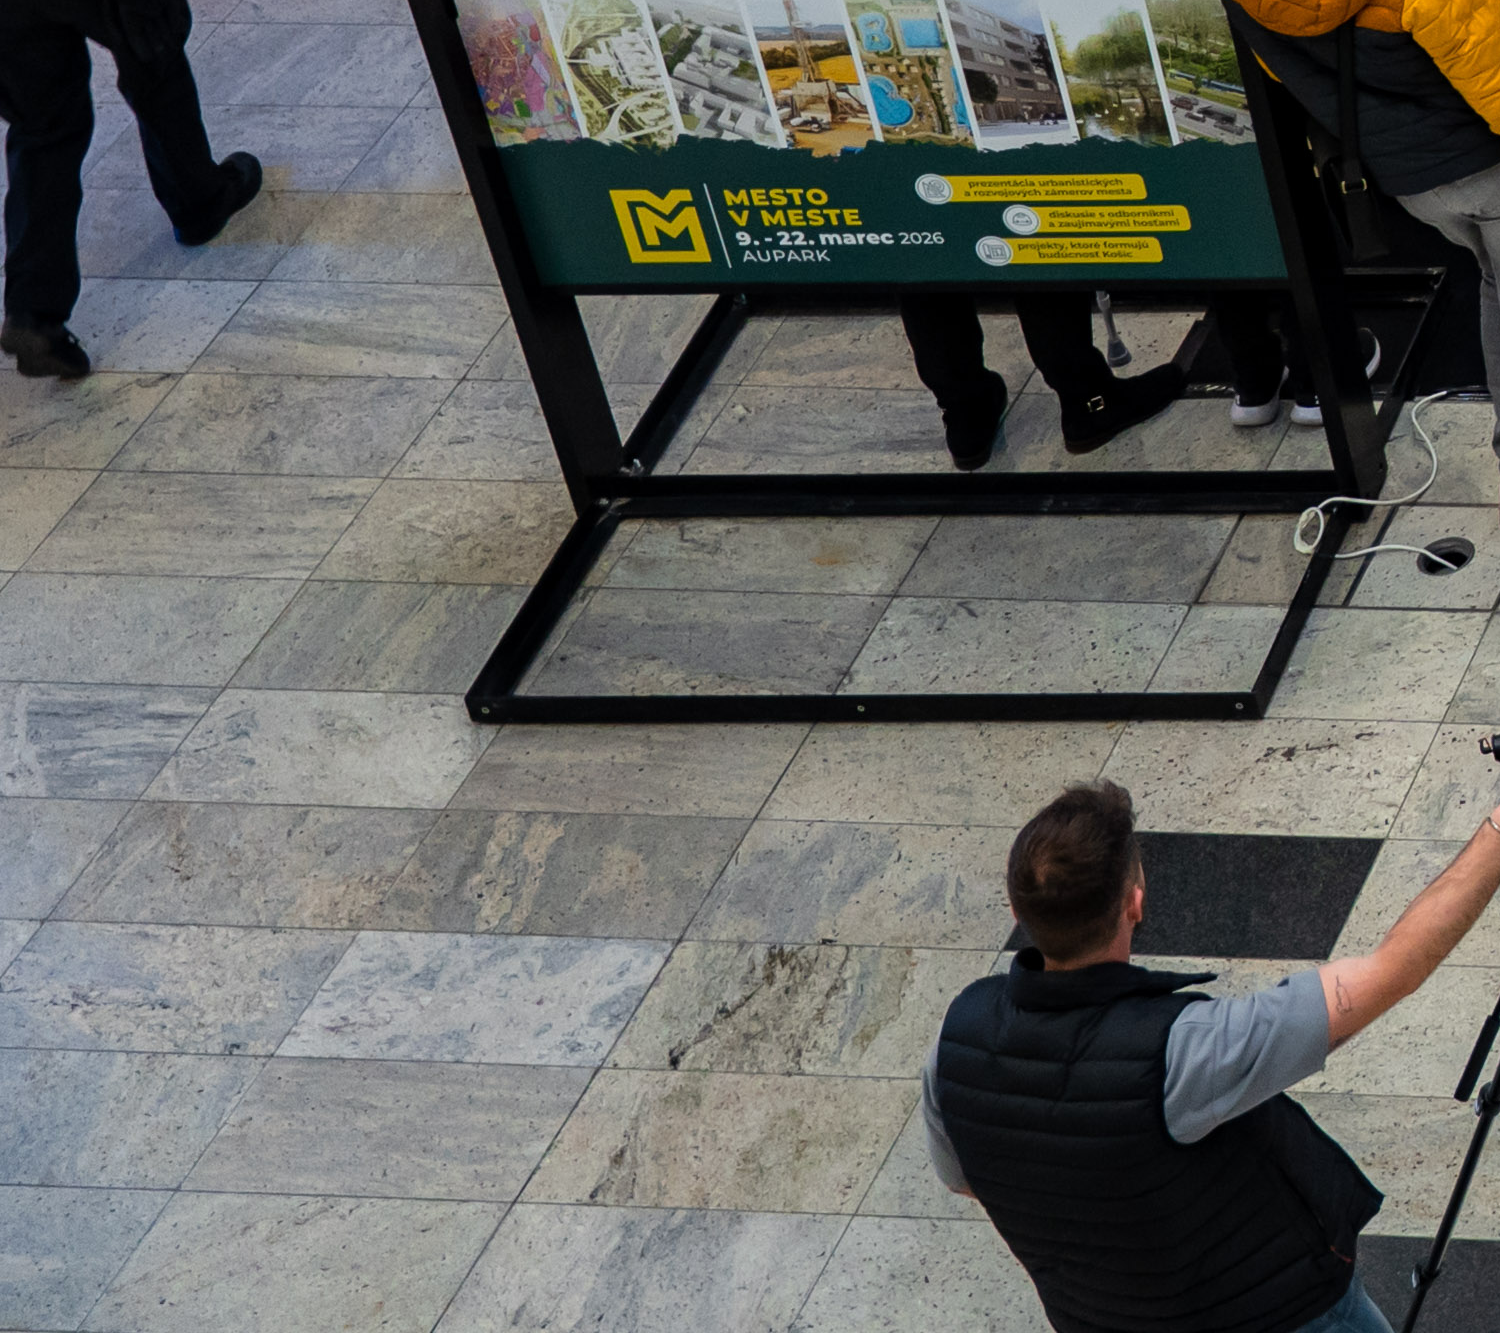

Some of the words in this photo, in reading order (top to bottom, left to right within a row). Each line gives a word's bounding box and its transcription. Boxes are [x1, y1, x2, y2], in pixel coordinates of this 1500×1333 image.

[968, 177, 1036, 189] prezentácia
[723, 188, 829, 207] MESTO
[1045, 187, 1094, 197] zámerov
[1097, 187, 1133, 196] mesta
[728, 210, 750, 227] V
[761, 208, 863, 227] MESTE
[1049, 210, 1096, 219] diskusie
[735, 232, 760, 247] 9.
[779, 231, 815, 247] 22.
[819, 232, 895, 246] marec
[898, 231, 945, 246] 2026
[742, 249, 831, 263] AUPARK
